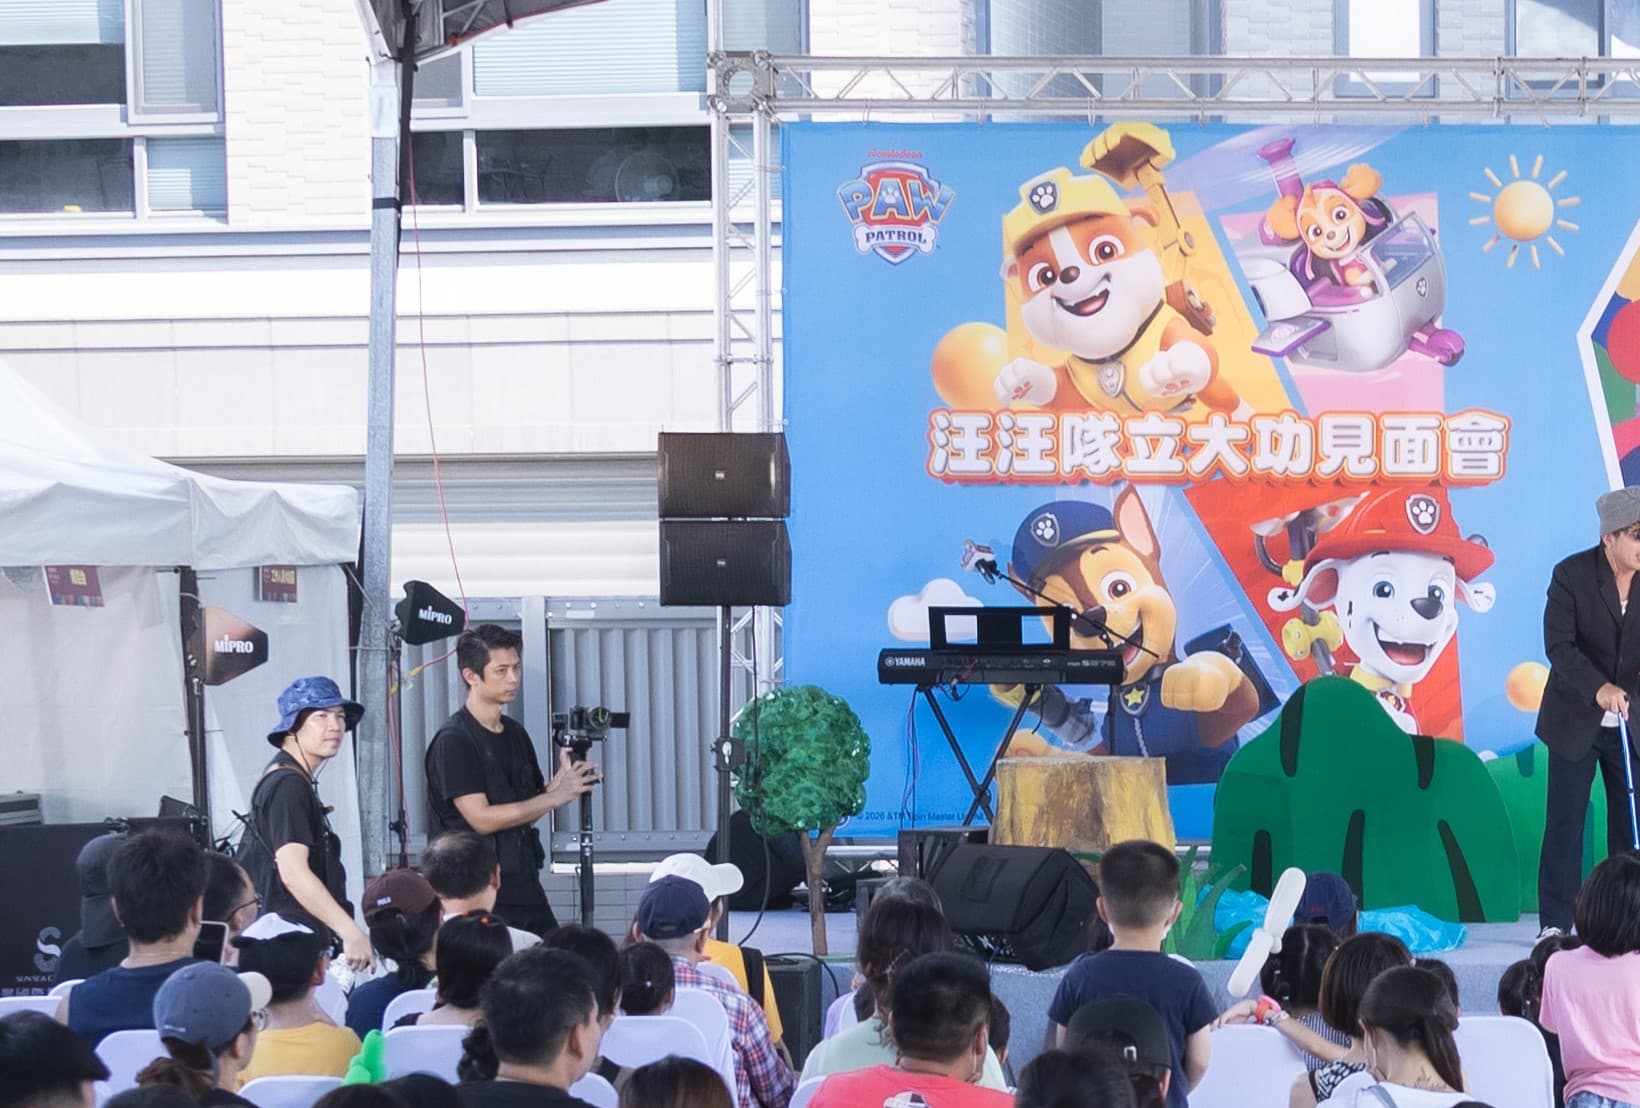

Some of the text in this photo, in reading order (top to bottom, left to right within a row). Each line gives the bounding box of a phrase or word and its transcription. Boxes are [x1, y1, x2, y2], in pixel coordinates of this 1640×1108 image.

[837, 178, 955, 225] PAW
[865, 230, 928, 244] PATROL
[930, 411, 1510, 480] 汪汪隊立大功見面會
[894, 656, 926, 667] YAMAHA
